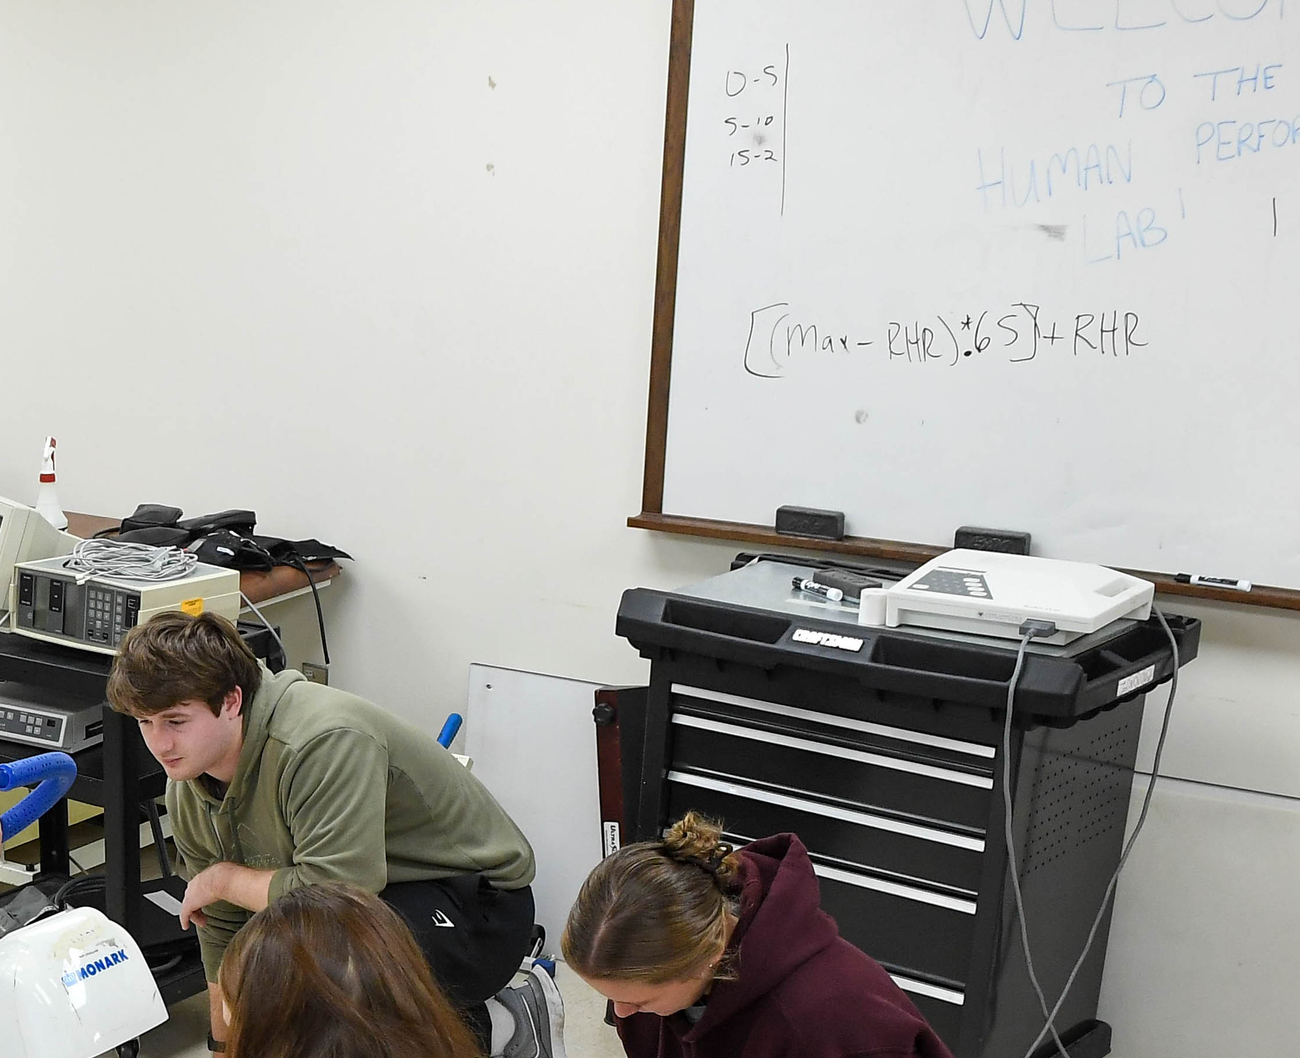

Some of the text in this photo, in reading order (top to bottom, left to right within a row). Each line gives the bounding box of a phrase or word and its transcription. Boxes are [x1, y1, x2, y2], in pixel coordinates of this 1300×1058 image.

[1106, 64, 1283, 118] TO THE
[976, 138, 1132, 211] HUMAN
[77, 949, 129, 982] MONARK
